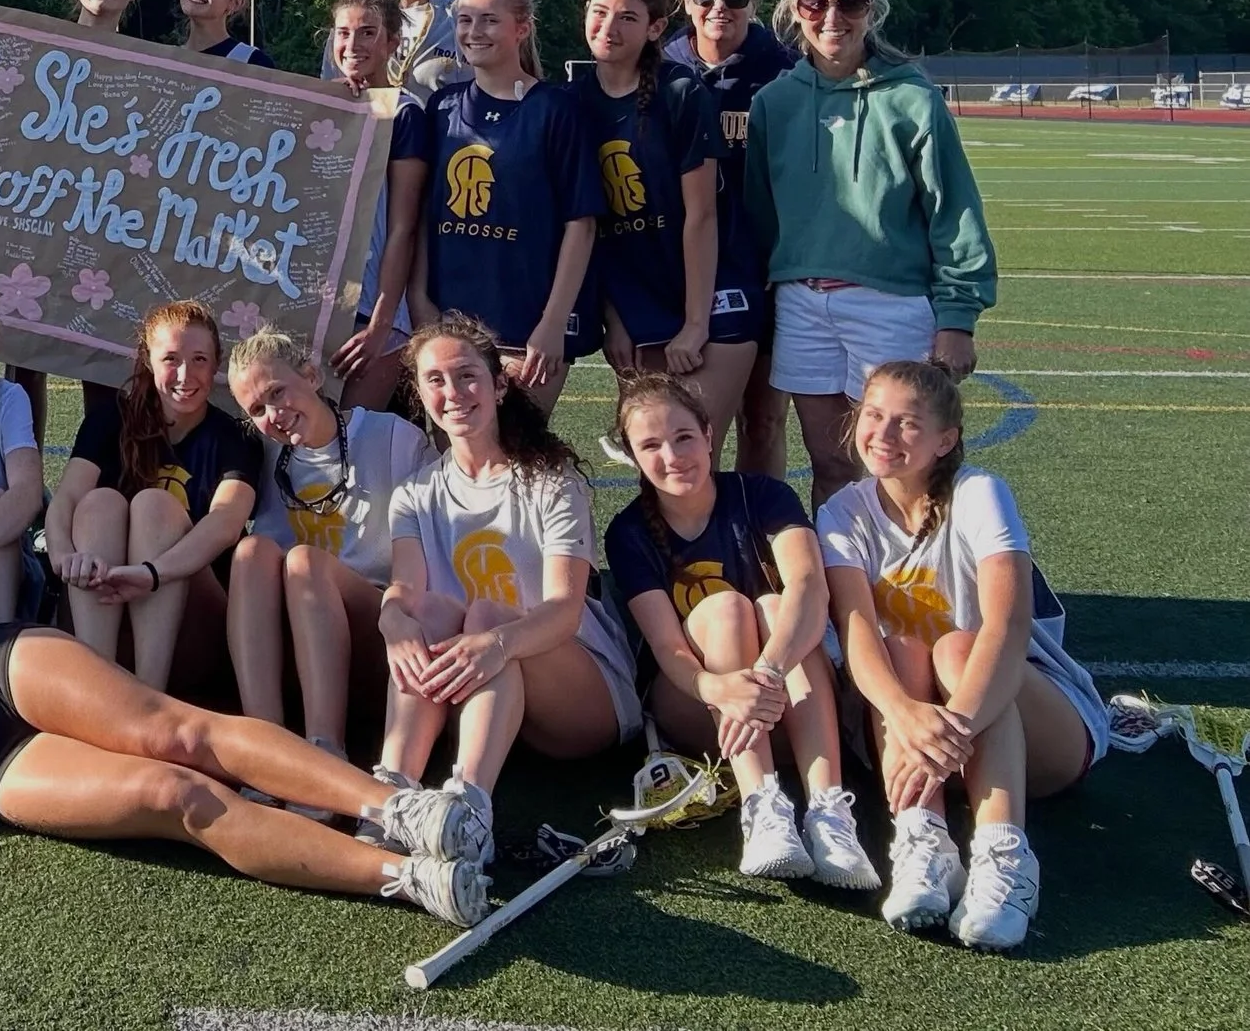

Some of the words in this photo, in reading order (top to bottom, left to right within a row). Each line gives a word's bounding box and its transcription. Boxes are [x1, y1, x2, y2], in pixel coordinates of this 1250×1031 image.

[20, 49, 150, 156] She's
[62, 168, 149, 250] the
[438, 221, 519, 241] CROSSE
[597, 833, 629, 853] STX
